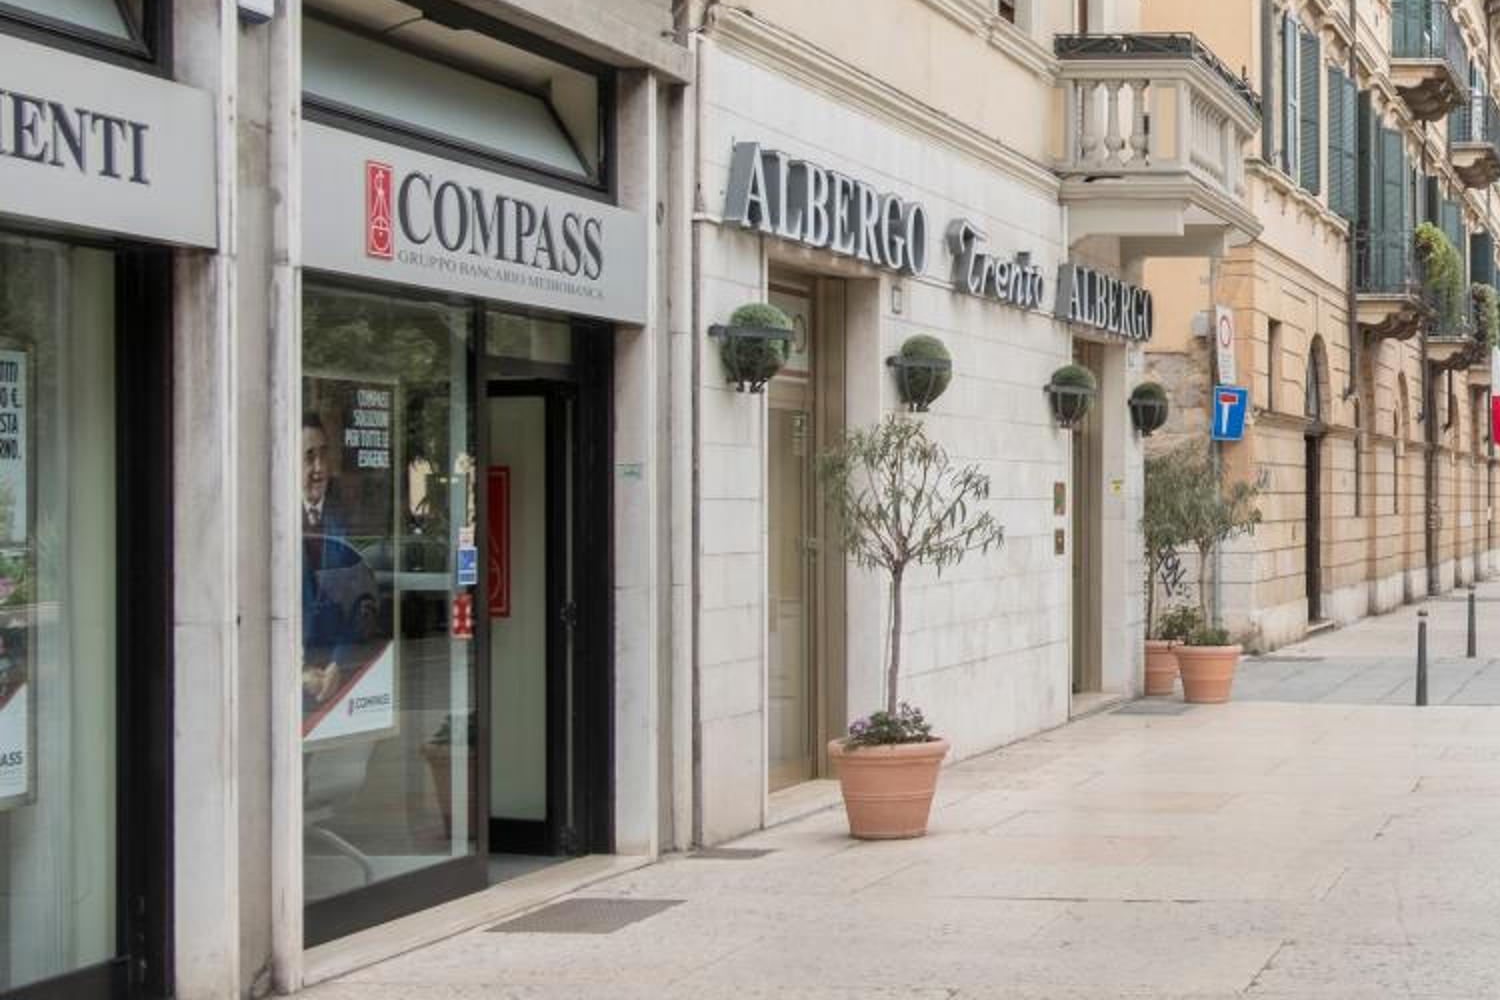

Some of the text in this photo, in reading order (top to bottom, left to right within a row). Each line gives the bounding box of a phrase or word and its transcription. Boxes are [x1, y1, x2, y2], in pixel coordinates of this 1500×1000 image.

[0, 88, 150, 185] ENTI
[398, 171, 604, 281] COMPASS
[399, 250, 457, 273] GRUPPO
[727, 141, 1154, 342] ALBERGO Trento ALBERGO
